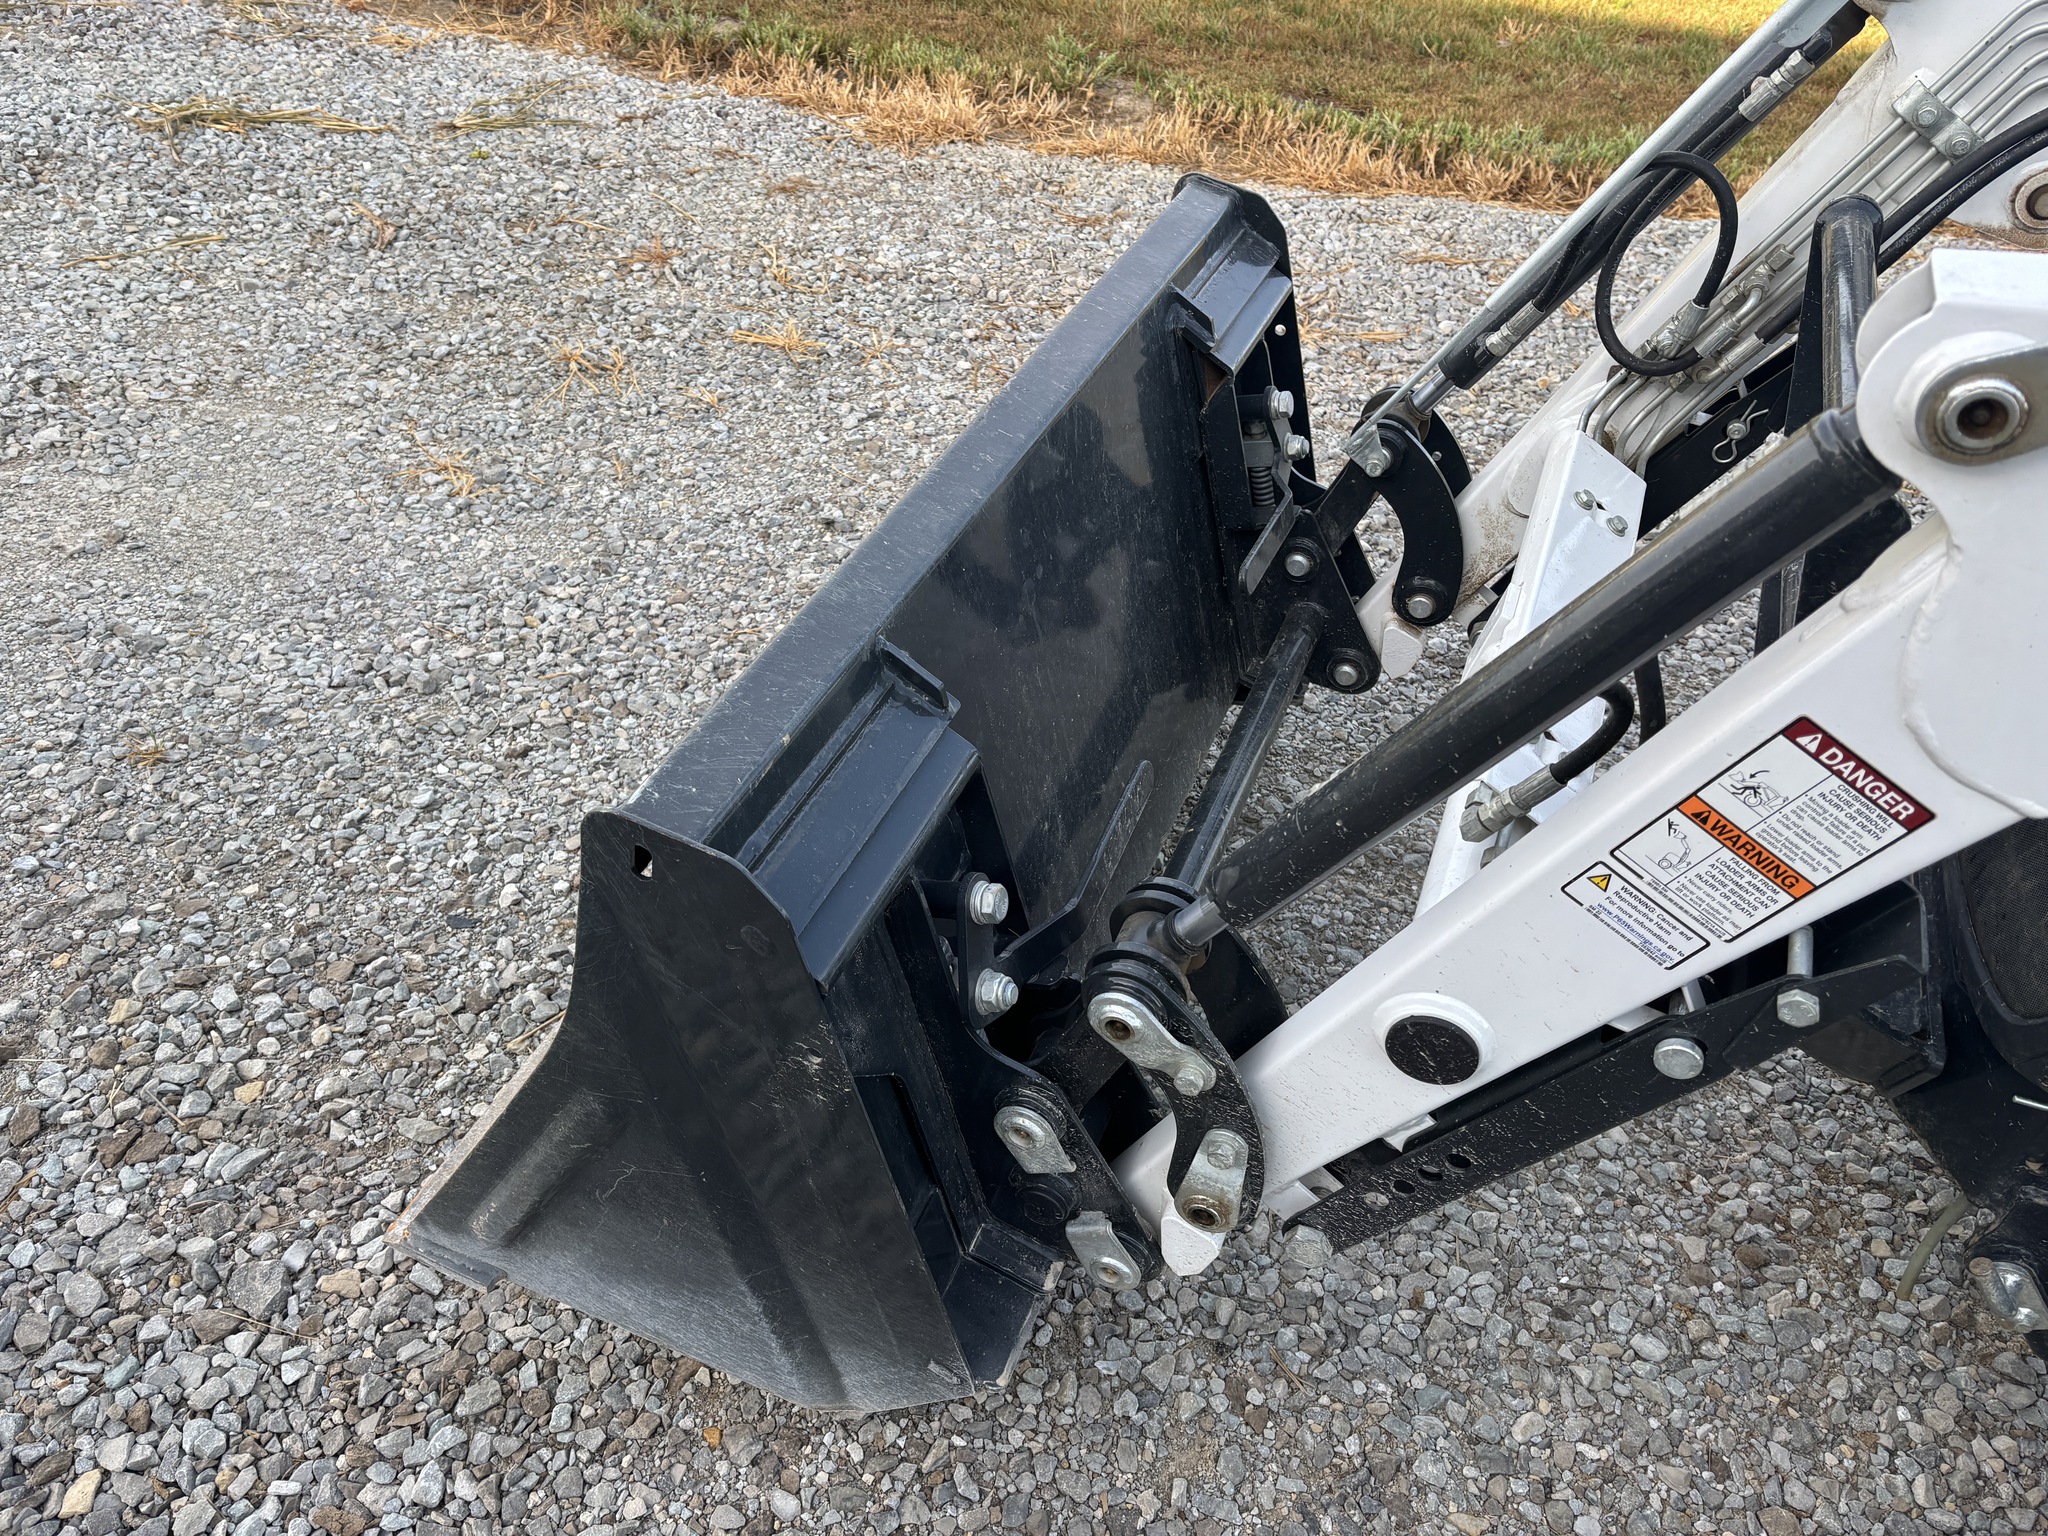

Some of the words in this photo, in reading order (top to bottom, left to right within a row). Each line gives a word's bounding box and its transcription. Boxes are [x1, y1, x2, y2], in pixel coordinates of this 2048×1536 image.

[1816, 746, 1918, 820] DANGER
[1835, 783, 1877, 814] CRUSHING
[1874, 812, 1896, 828] WILL
[1788, 808, 1807, 821] drop.
[1794, 805, 1808, 814] can
[1806, 813, 1825, 827] cause
[1823, 825, 1844, 840] loader
[1840, 839, 1857, 851] arms
[1800, 800, 1823, 817] control
[1827, 820, 1848, 835] failure
[1855, 842, 1871, 853] part
[1805, 796, 1830, 814] Moving
[1832, 815, 1853, 830] loader
[1850, 829, 1864, 839] arm
[1816, 791, 1846, 813] INJURY
[1842, 811, 1858, 822] OR
[1854, 820, 1882, 840] DEATH
[1827, 788, 1856, 809] CAUSE
[1852, 807, 1888, 833] SERIOUS
[1706, 818, 1802, 889] WARNING
[1753, 831, 1784, 853] operator's
[1781, 851, 1798, 863] seat.
[1759, 827, 1782, 844] ground
[1779, 842, 1800, 857] before
[1796, 855, 1820, 872] leaving
[1765, 823, 1785, 837] Lower
[1782, 836, 1803, 851] loader
[1800, 850, 1816, 861] arms
[1821, 865, 1834, 874] the
[1775, 817, 1794, 831] under
[1791, 829, 1811, 844] raised
[1808, 842, 1829, 857] loader
[1826, 856, 1844, 869] arms.
[1780, 813, 1792, 822] Do
[1789, 820, 1802, 829] not
[1799, 827, 1818, 841] reach
[1822, 844, 1841, 858] stand
[1686, 878, 1704, 891] Never
[1701, 890, 1716, 902] carry
[1715, 900, 1735, 914] riders.
[1693, 873, 1721, 893] INJURY
[1718, 891, 1732, 901] OR
[1729, 899, 1754, 918] DEATH
[1703, 870, 1730, 889] CAUSE
[1727, 887, 1759, 911] SERIOUS
[1707, 862, 1755, 897] ATTACHMENT
[1752, 896, 1770, 909] CAN
[1714, 857, 1745, 880] LOADER
[1744, 879, 1768, 896] ARMS
[1764, 895, 1779, 905] OR
[1728, 857, 1760, 880] FALLING
[1756, 878, 1780, 895] FROM
[1604, 896, 1618, 906] For
[1615, 905, 1633, 918] more
[1632, 917, 1670, 945] information
[1665, 944, 1677, 953] go
[1611, 890, 1655, 923] Reproductive
[1652, 921, 1673, 936] Harm
[1618, 885, 1658, 915] WARNING:
[1655, 913, 1681, 932] Cancer
[1677, 930, 1693, 941] and
[1679, 883, 1697, 896] Never
[1694, 895, 1705, 903] use
[1704, 902, 1723, 916] loader
[1728, 920, 1742, 930] man
[1688, 897, 1703, 908] work
[1700, 907, 1726, 925] platform.
